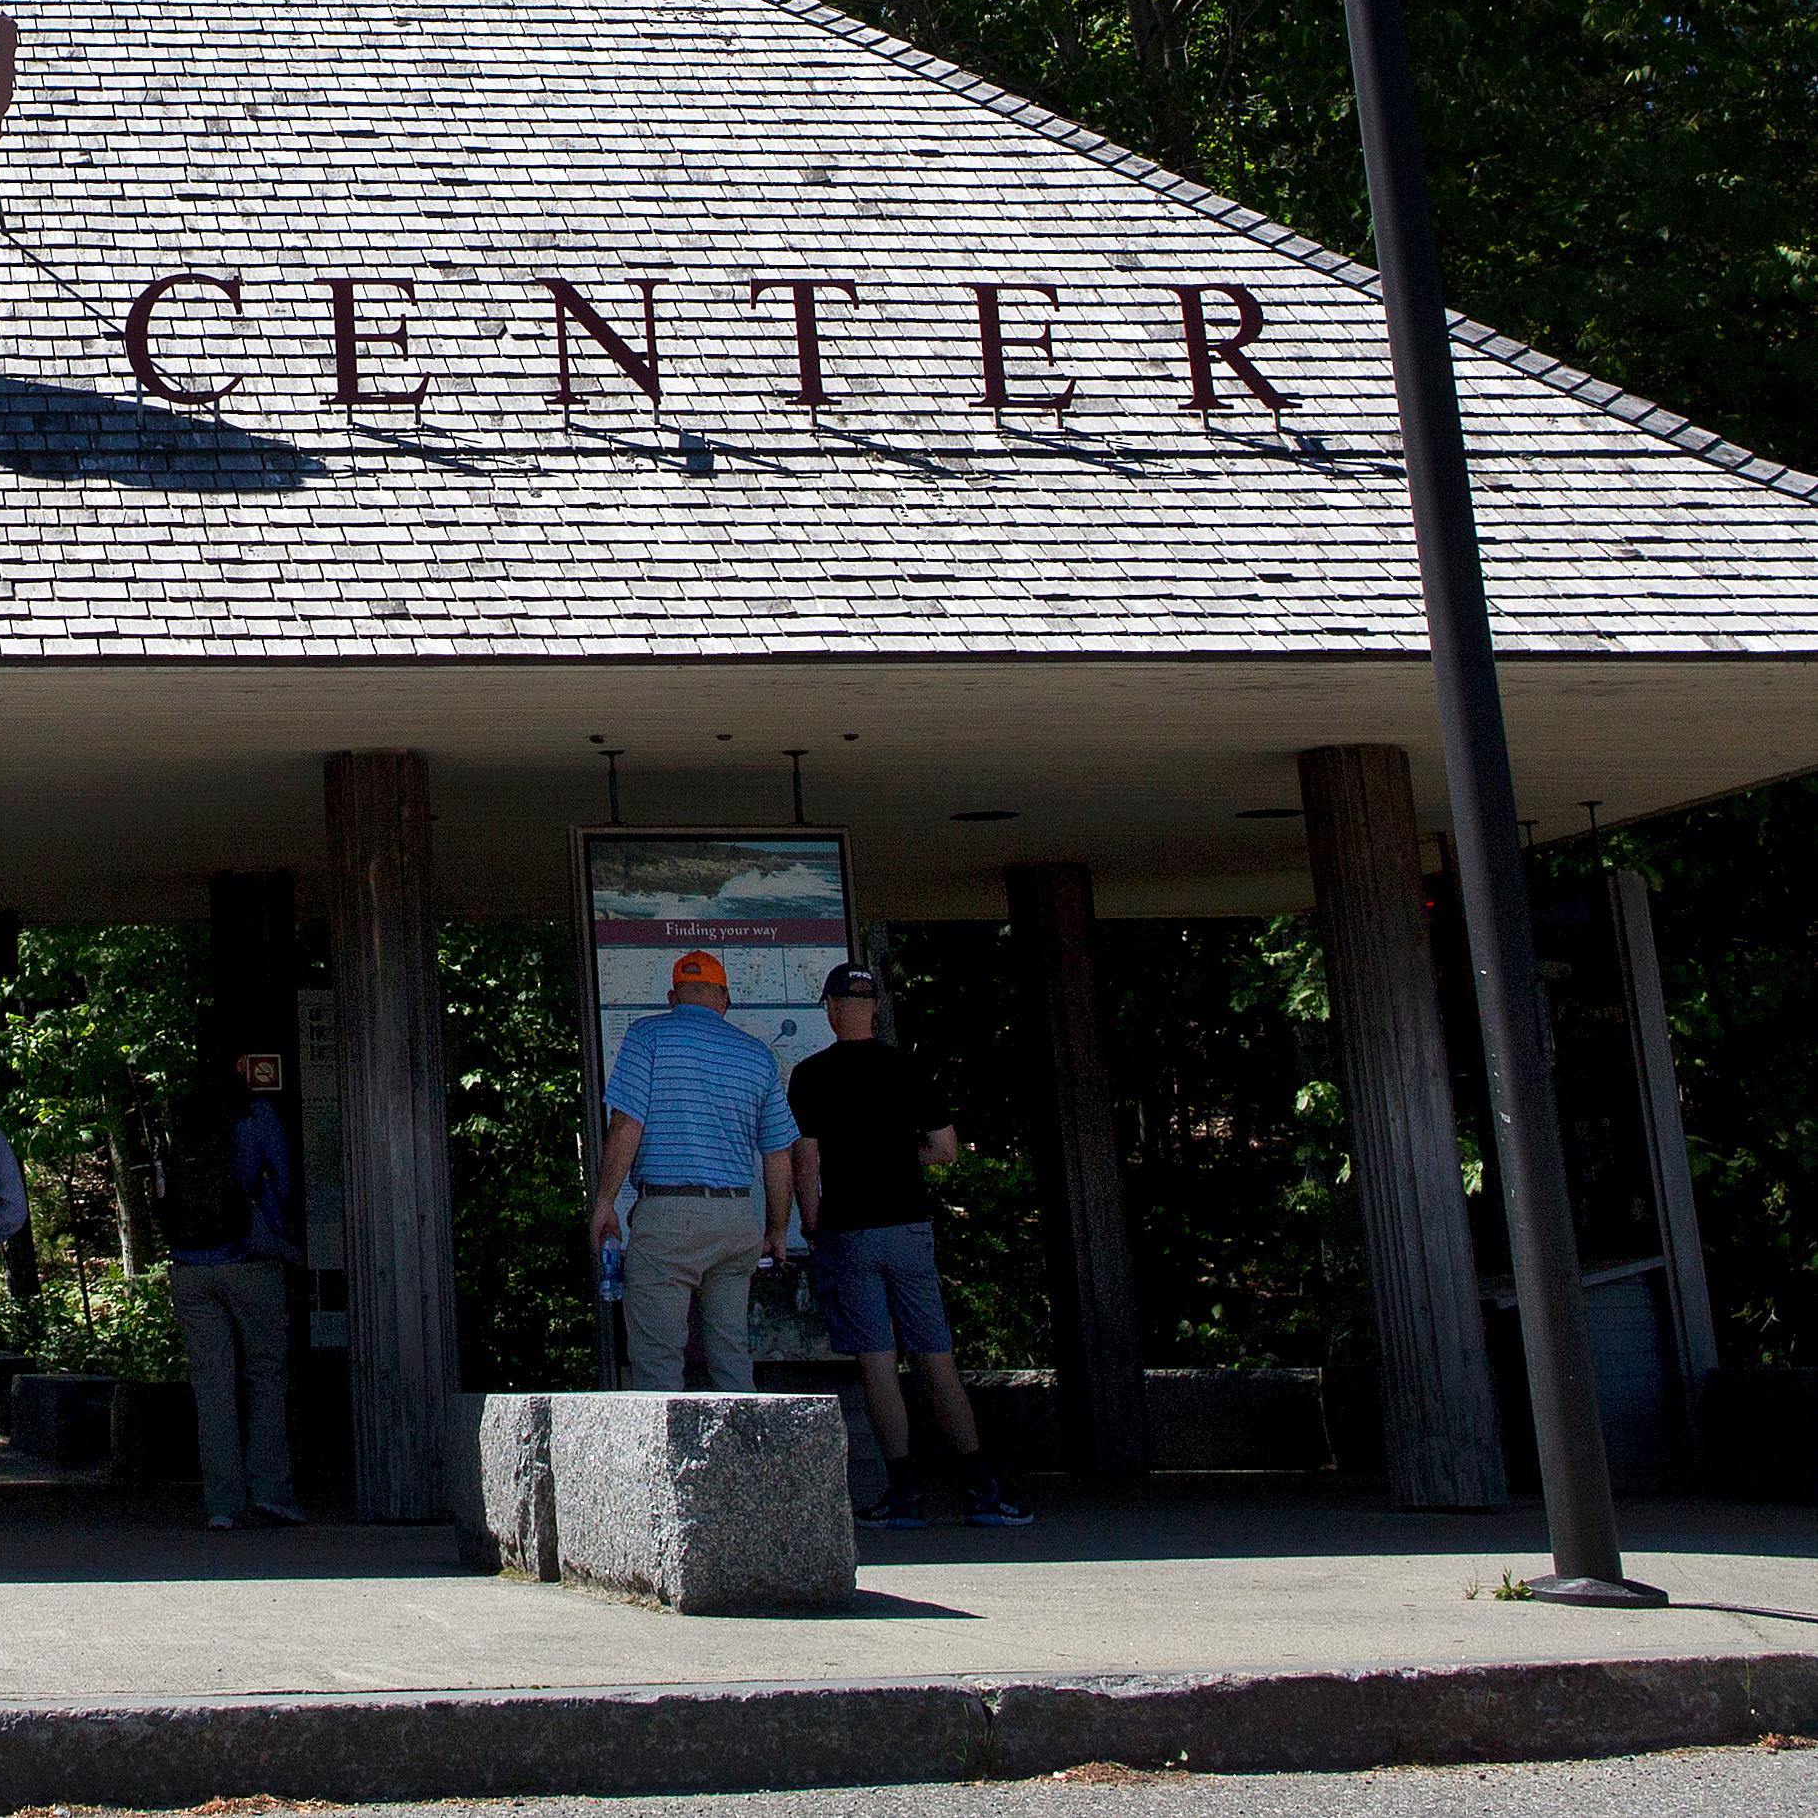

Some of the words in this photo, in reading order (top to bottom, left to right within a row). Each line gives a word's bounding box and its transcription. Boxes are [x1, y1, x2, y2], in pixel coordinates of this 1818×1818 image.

[123, 273, 1303, 411] CENTER
[665, 922, 717, 941] Finding
[719, 926, 750, 941] your
[752, 926, 778, 941] way
